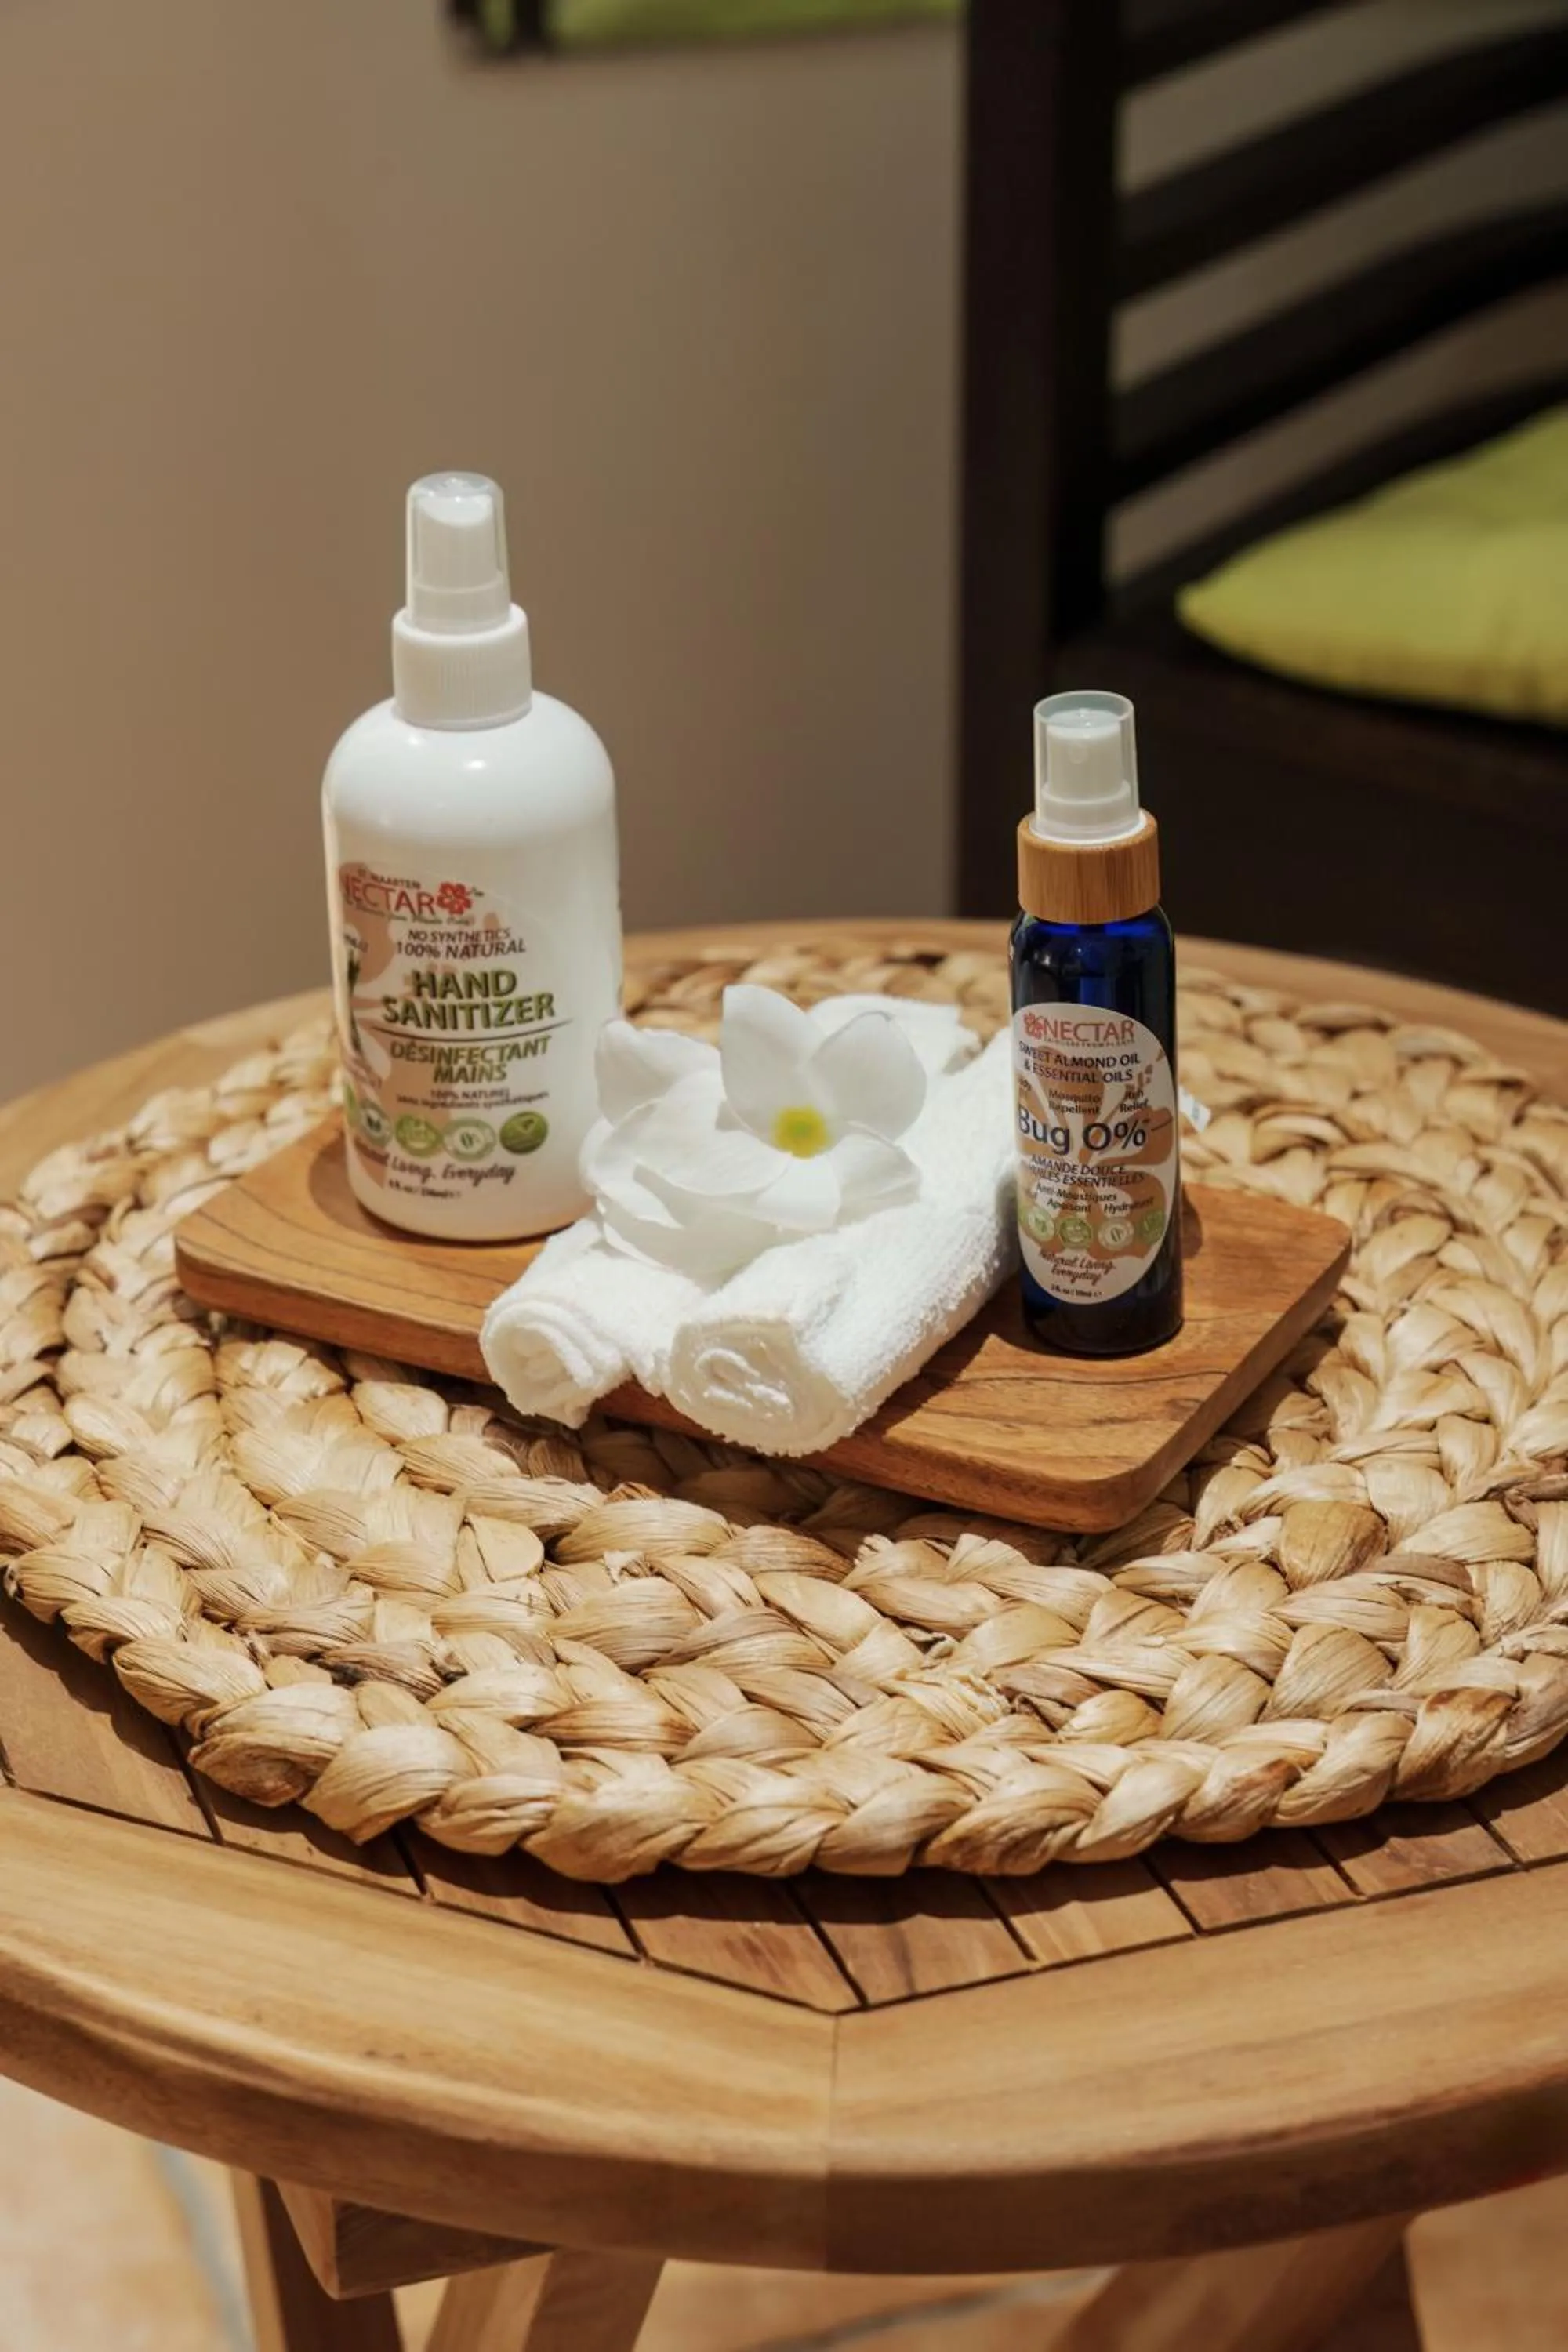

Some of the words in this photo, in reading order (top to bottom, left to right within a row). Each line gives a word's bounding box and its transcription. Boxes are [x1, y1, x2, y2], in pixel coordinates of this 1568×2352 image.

[408, 929, 428, 942] NO
[430, 927, 511, 943] SYNTHETICS
[396, 941, 441, 958] 100%
[445, 938, 527, 960] NATURAL
[412, 969, 517, 1000] HAND
[381, 992, 556, 1030] SANITIZER
[1044, 1018, 1135, 1042] NECTAR
[1055, 1054, 1116, 1068] ALMOND
[1120, 1052, 1141, 1066] OIL
[433, 1062, 508, 1083] MAINS
[1033, 1062, 1098, 1084] ESSENTIAL
[1102, 1069, 1134, 1083] OILS
[1018, 1103, 1071, 1156] Bug
[1082, 1119, 1147, 1152] 0%
[1030, 1154, 1079, 1174] AMANDE
[1080, 1163, 1127, 1176] DOUCE
